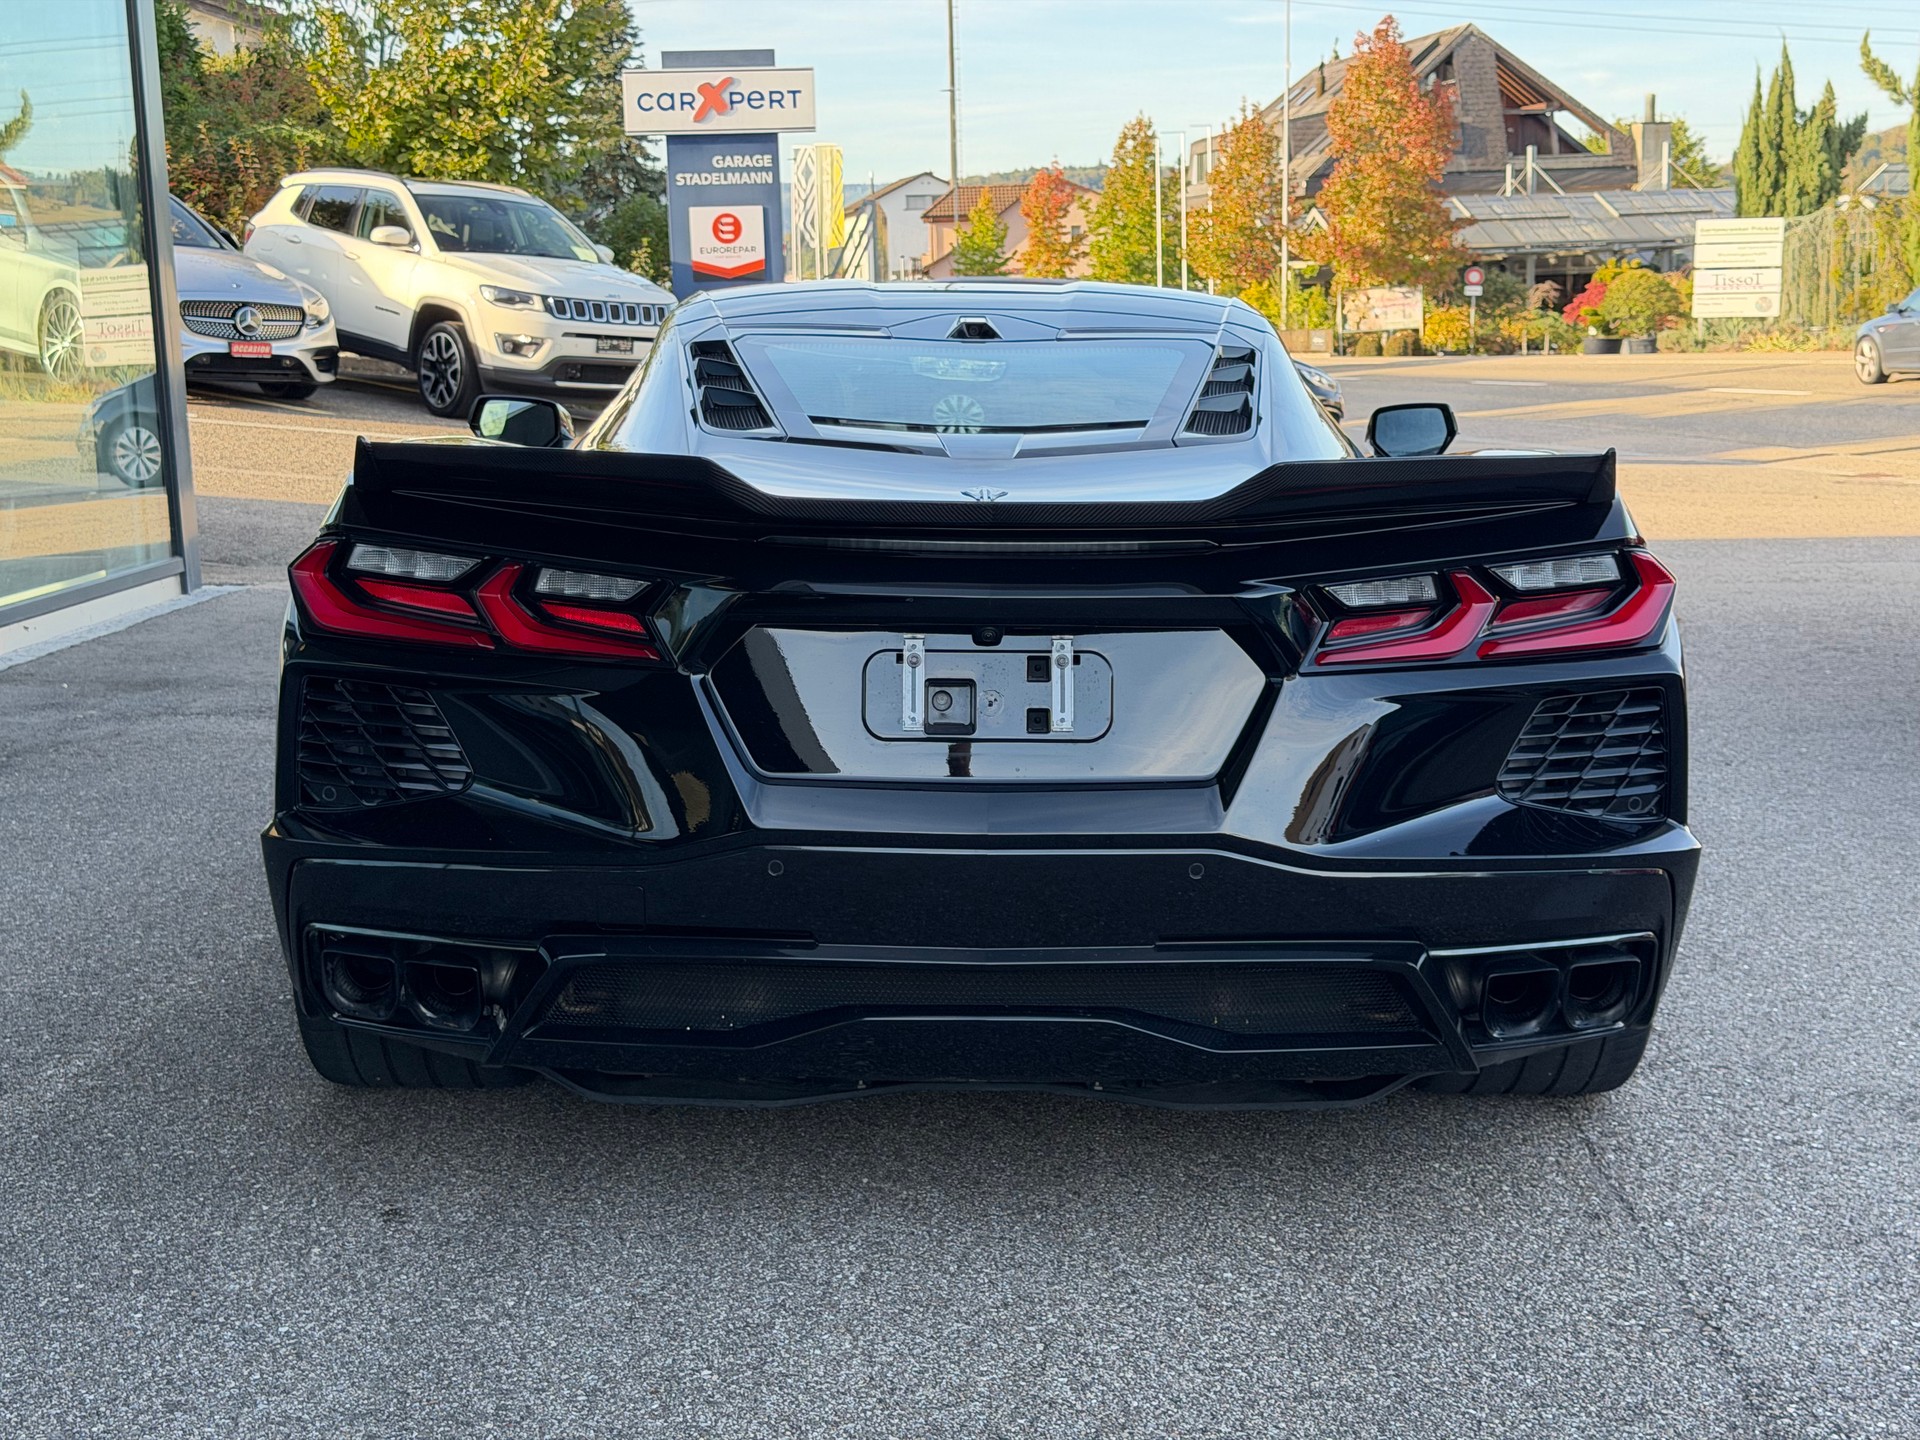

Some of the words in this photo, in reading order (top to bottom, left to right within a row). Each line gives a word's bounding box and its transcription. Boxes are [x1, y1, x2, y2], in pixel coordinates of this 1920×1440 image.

[712, 154, 773, 168] GARAGE
[675, 171, 773, 186] STADELMANN
[700, 246, 757, 255] EUROREPAR
[233, 344, 271, 353] OCCASION
